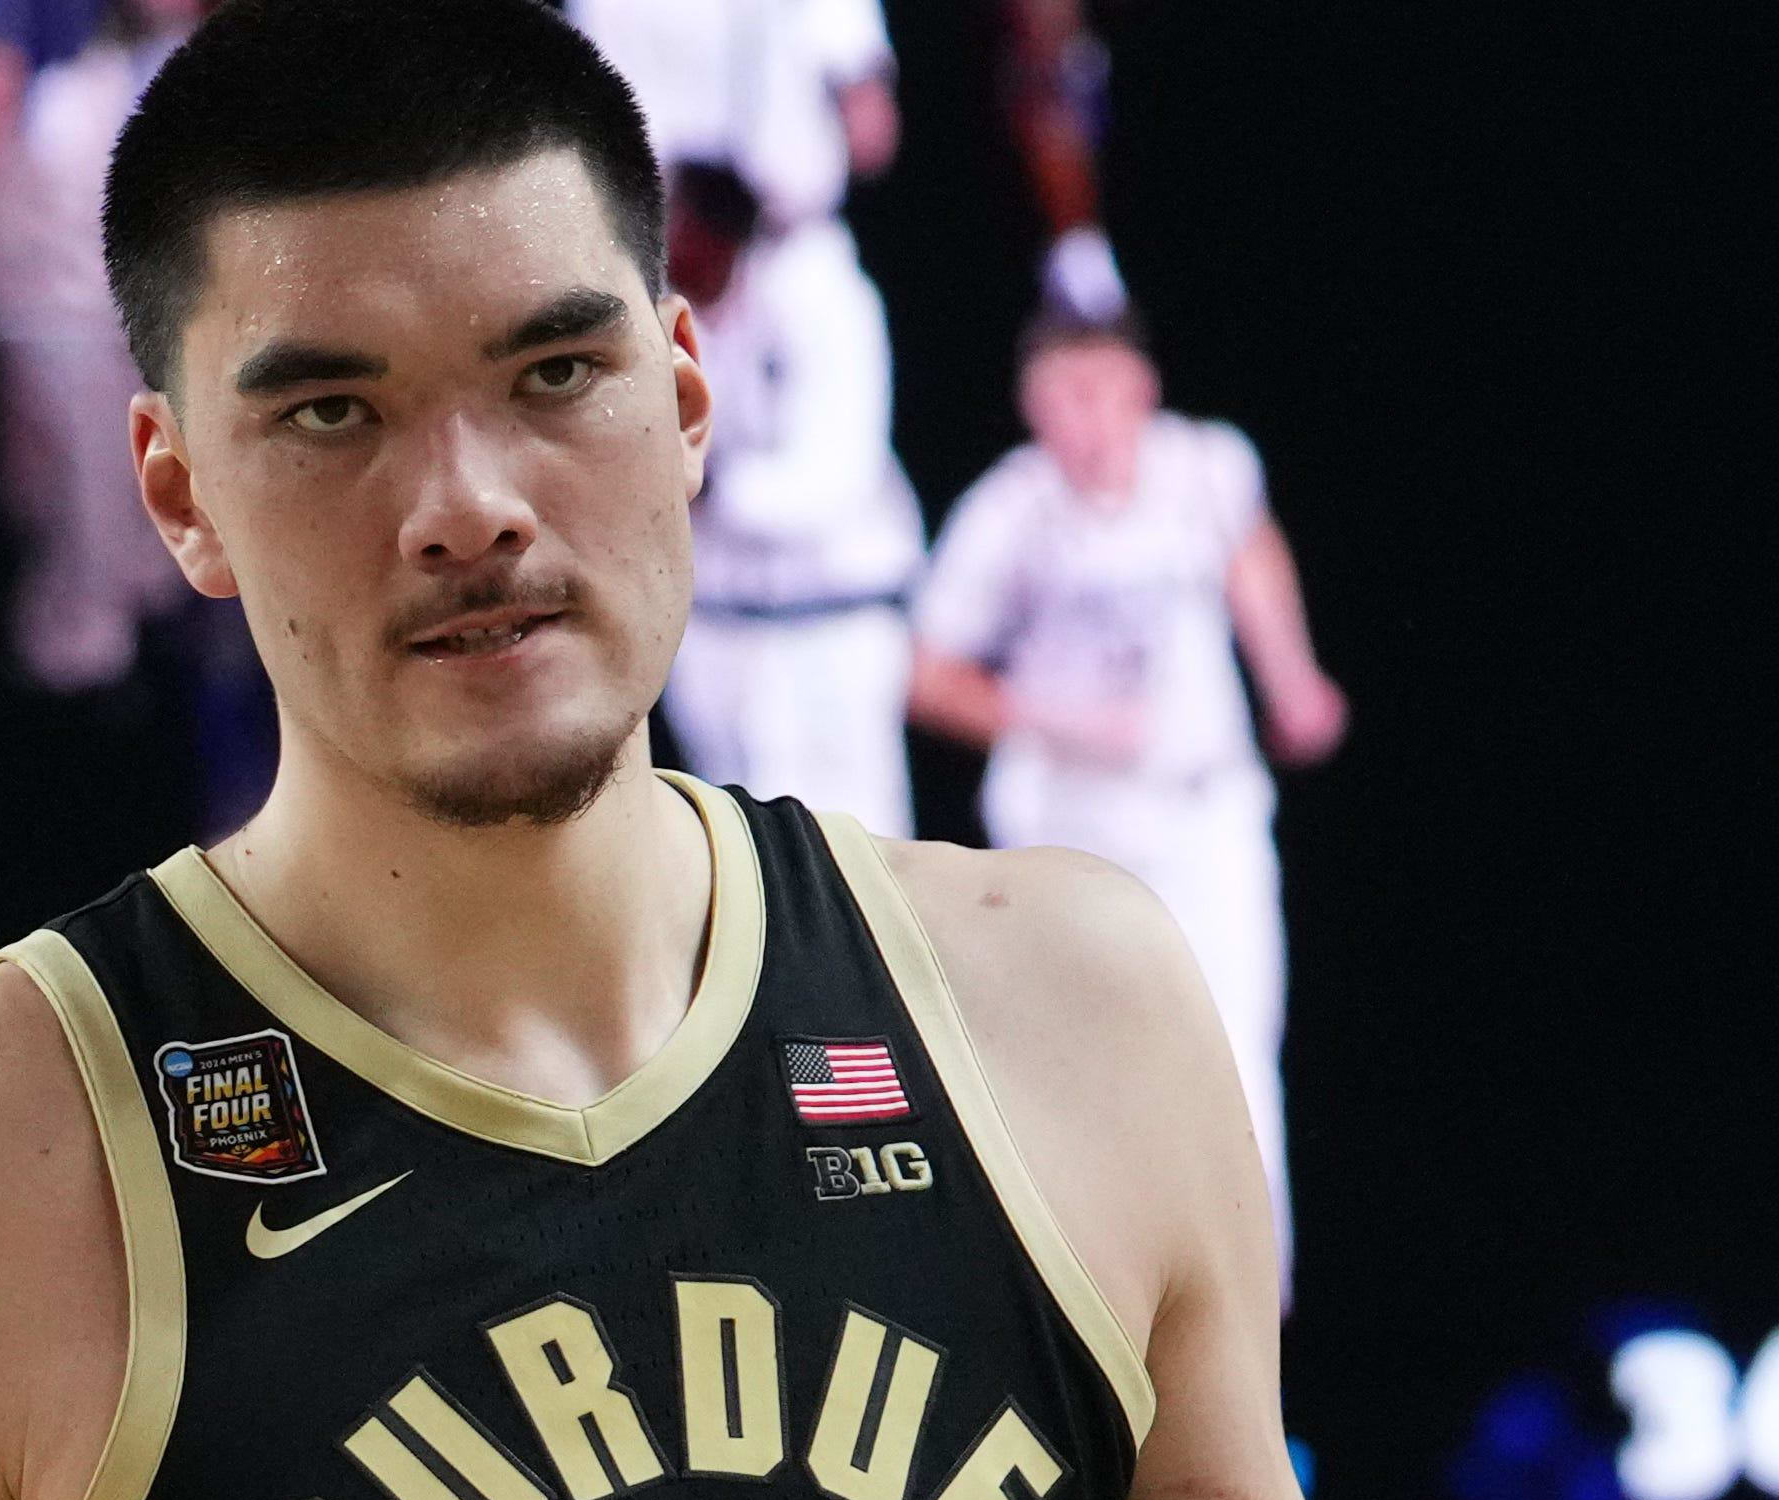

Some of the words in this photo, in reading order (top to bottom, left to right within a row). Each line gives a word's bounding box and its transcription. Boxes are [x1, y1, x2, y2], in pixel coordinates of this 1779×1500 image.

[186, 1064, 269, 1105] FINAL
[193, 1093, 272, 1132] FOUR
[210, 1130, 268, 1147] PHOENIX
